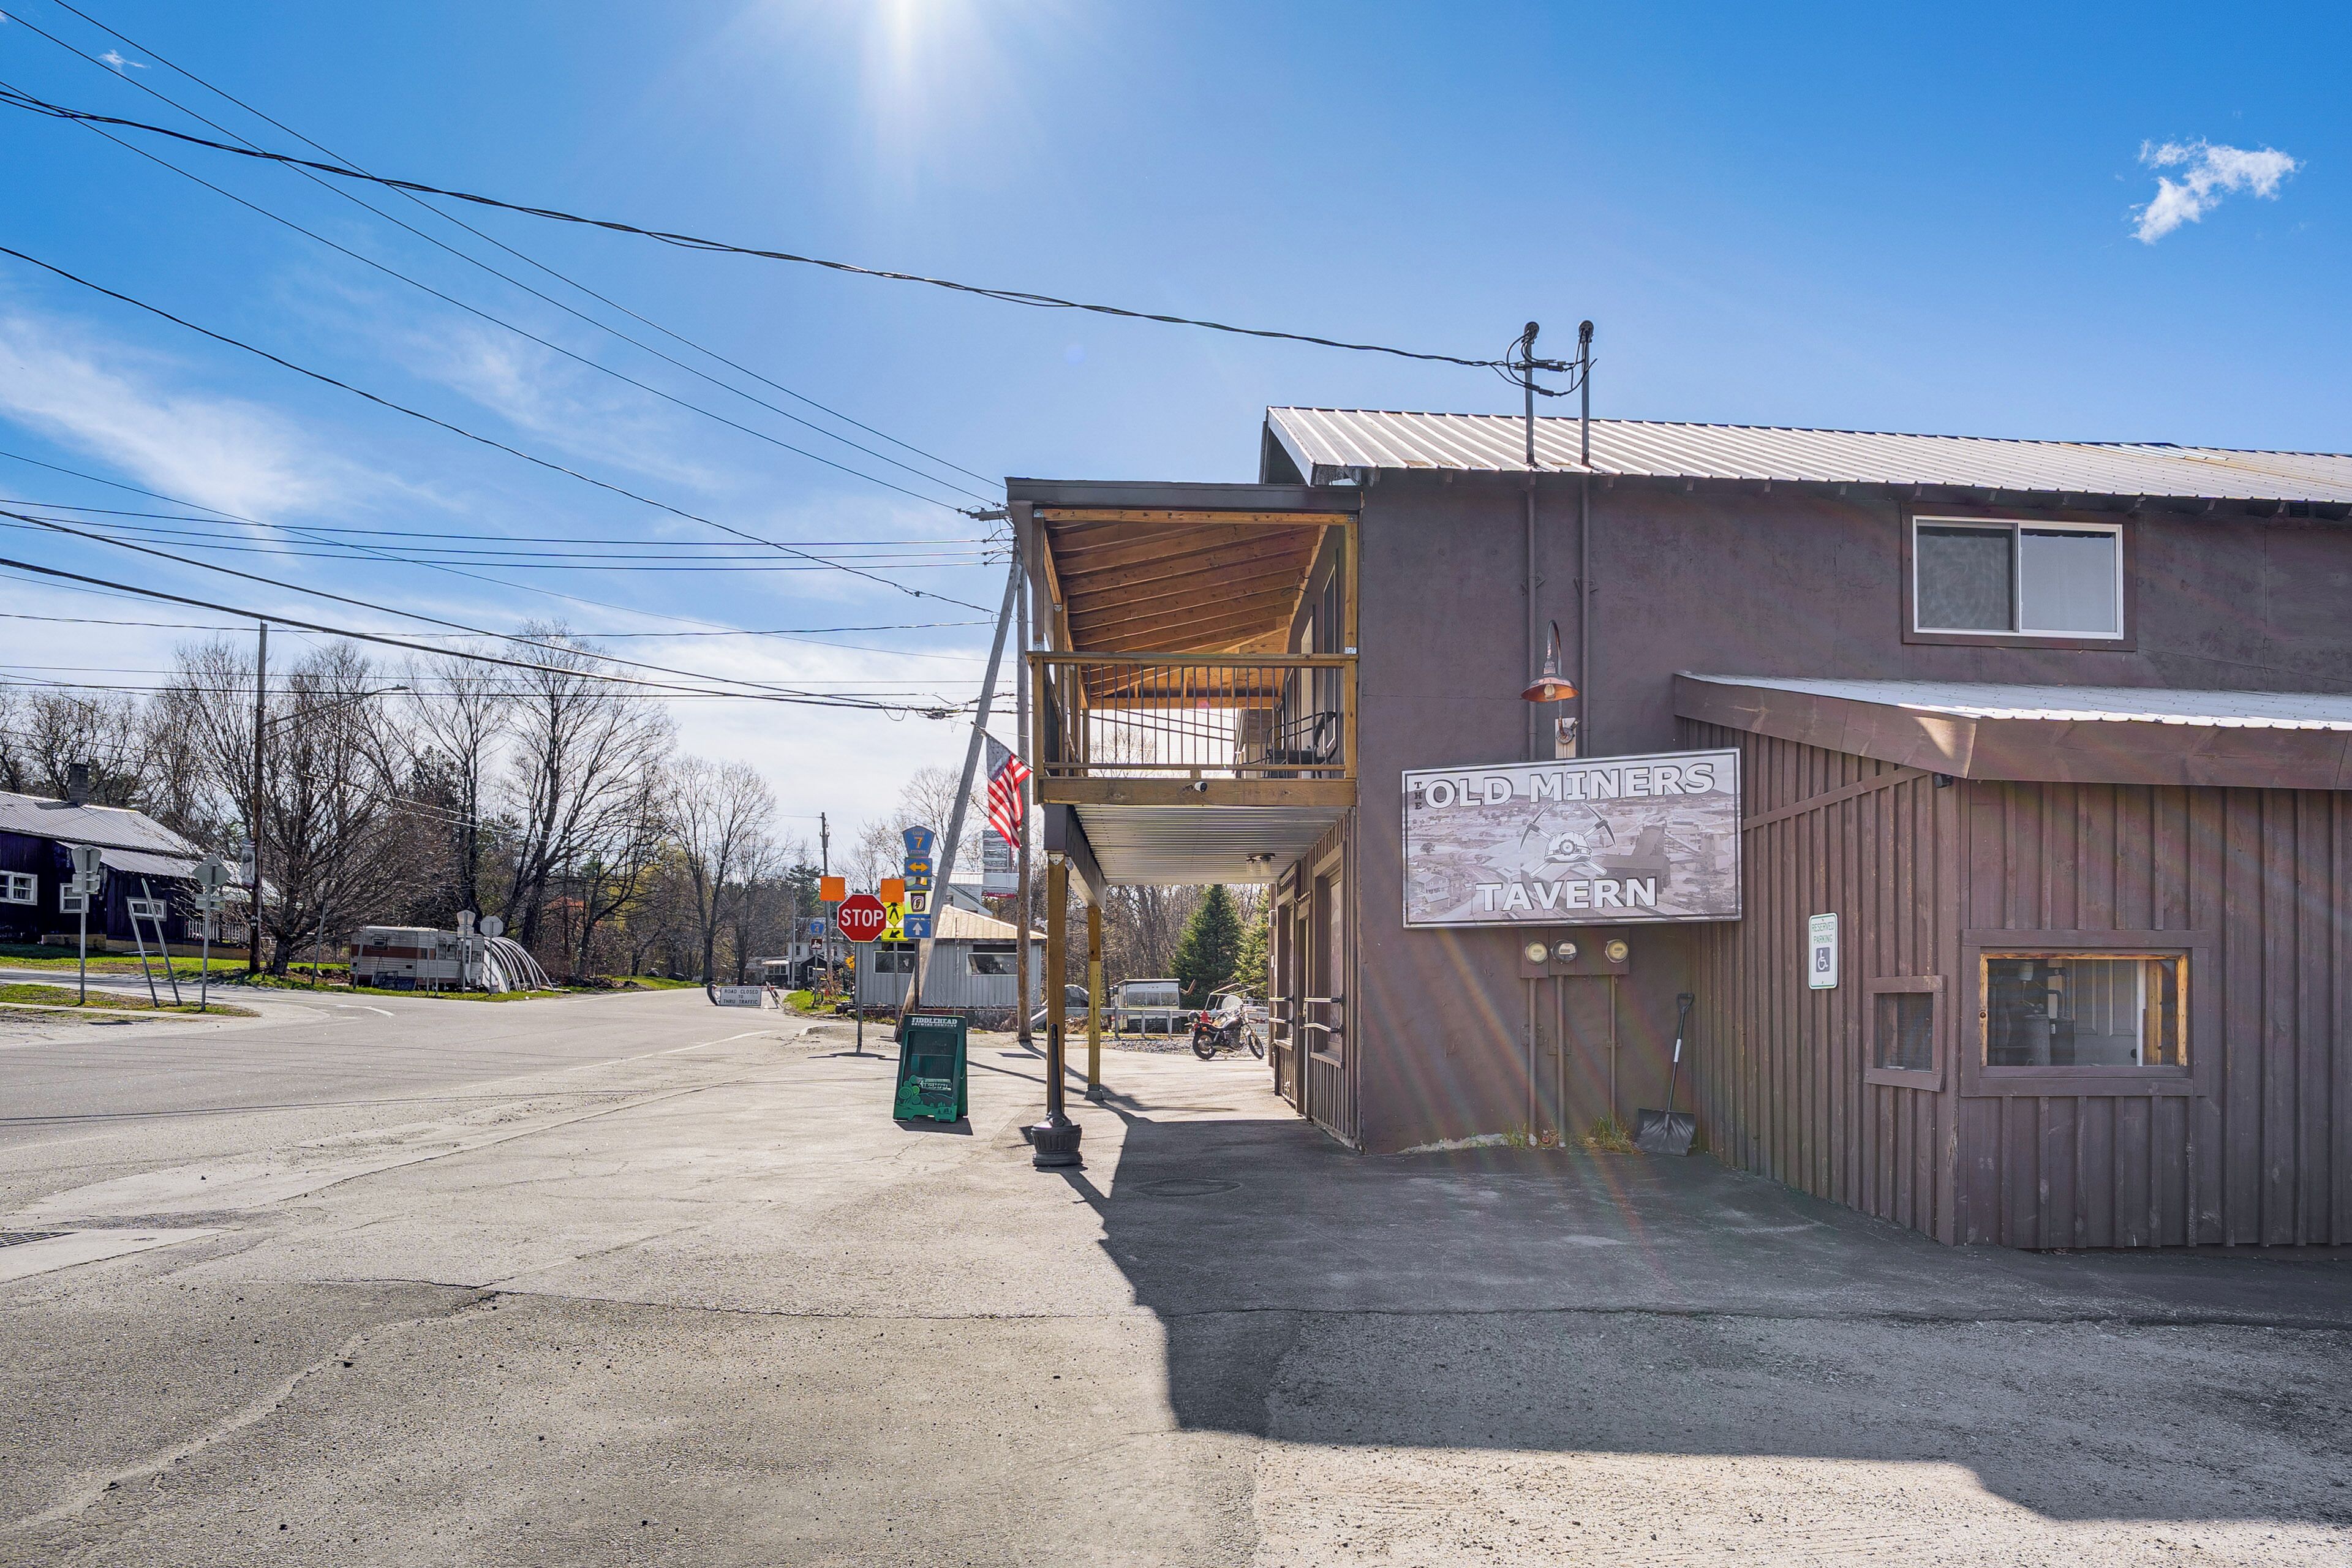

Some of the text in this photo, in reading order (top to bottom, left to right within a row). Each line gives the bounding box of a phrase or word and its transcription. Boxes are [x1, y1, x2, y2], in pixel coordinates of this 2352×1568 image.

[1425, 763, 1715, 809] OLD MINERS
[914, 837, 924, 848] 7
[1475, 876, 1657, 911] TAVERN
[841, 908, 884, 927] STOP
[1812, 921, 1834, 932] RESERVED
[1814, 934, 1833, 944] PARKING
